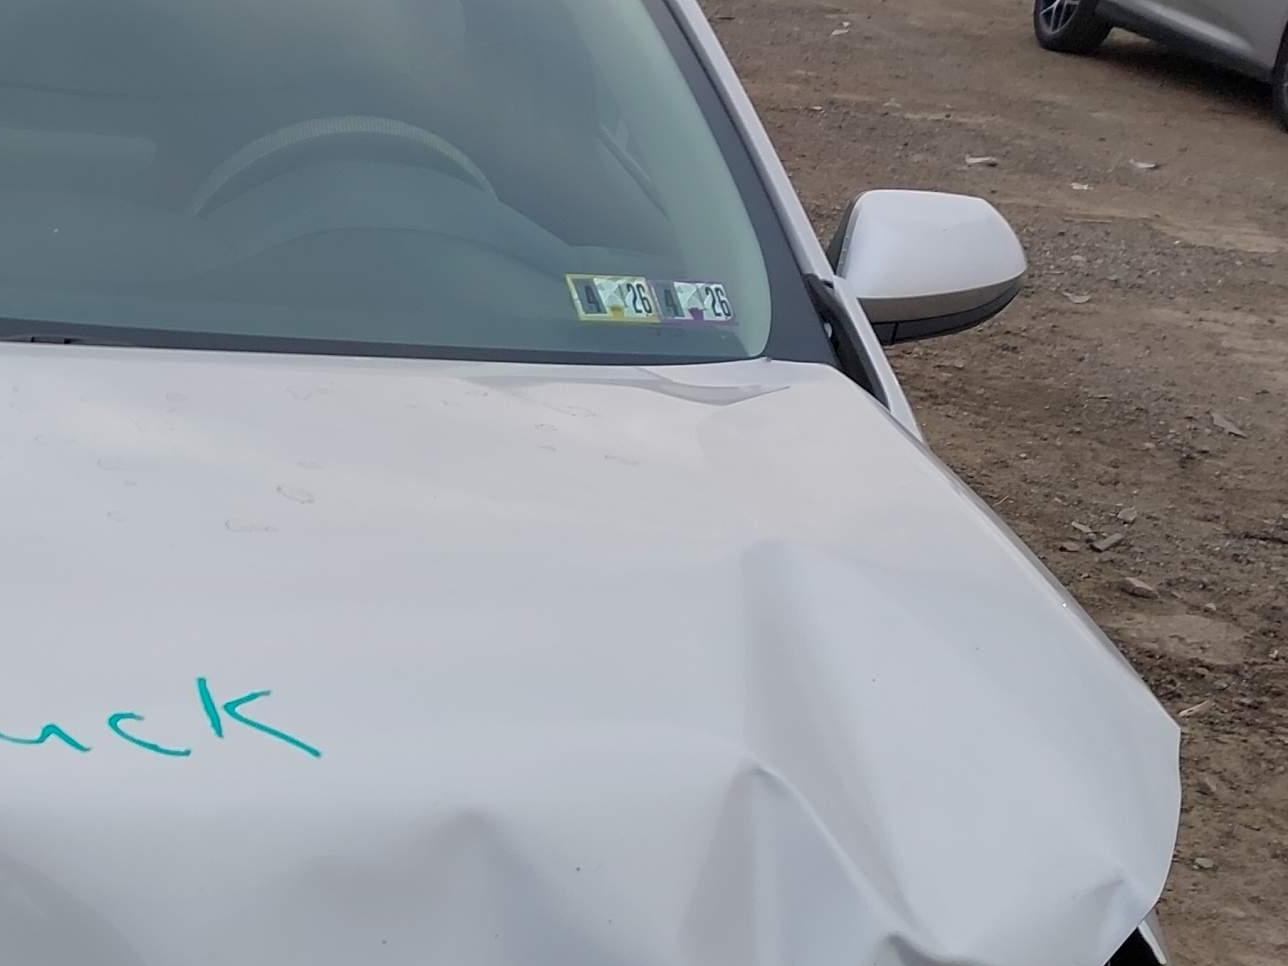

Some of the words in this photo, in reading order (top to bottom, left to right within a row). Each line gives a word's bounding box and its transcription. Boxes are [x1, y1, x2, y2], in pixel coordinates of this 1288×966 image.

[584, 285, 601, 313] 4
[626, 283, 653, 314] 26
[704, 287, 731, 317] 26
